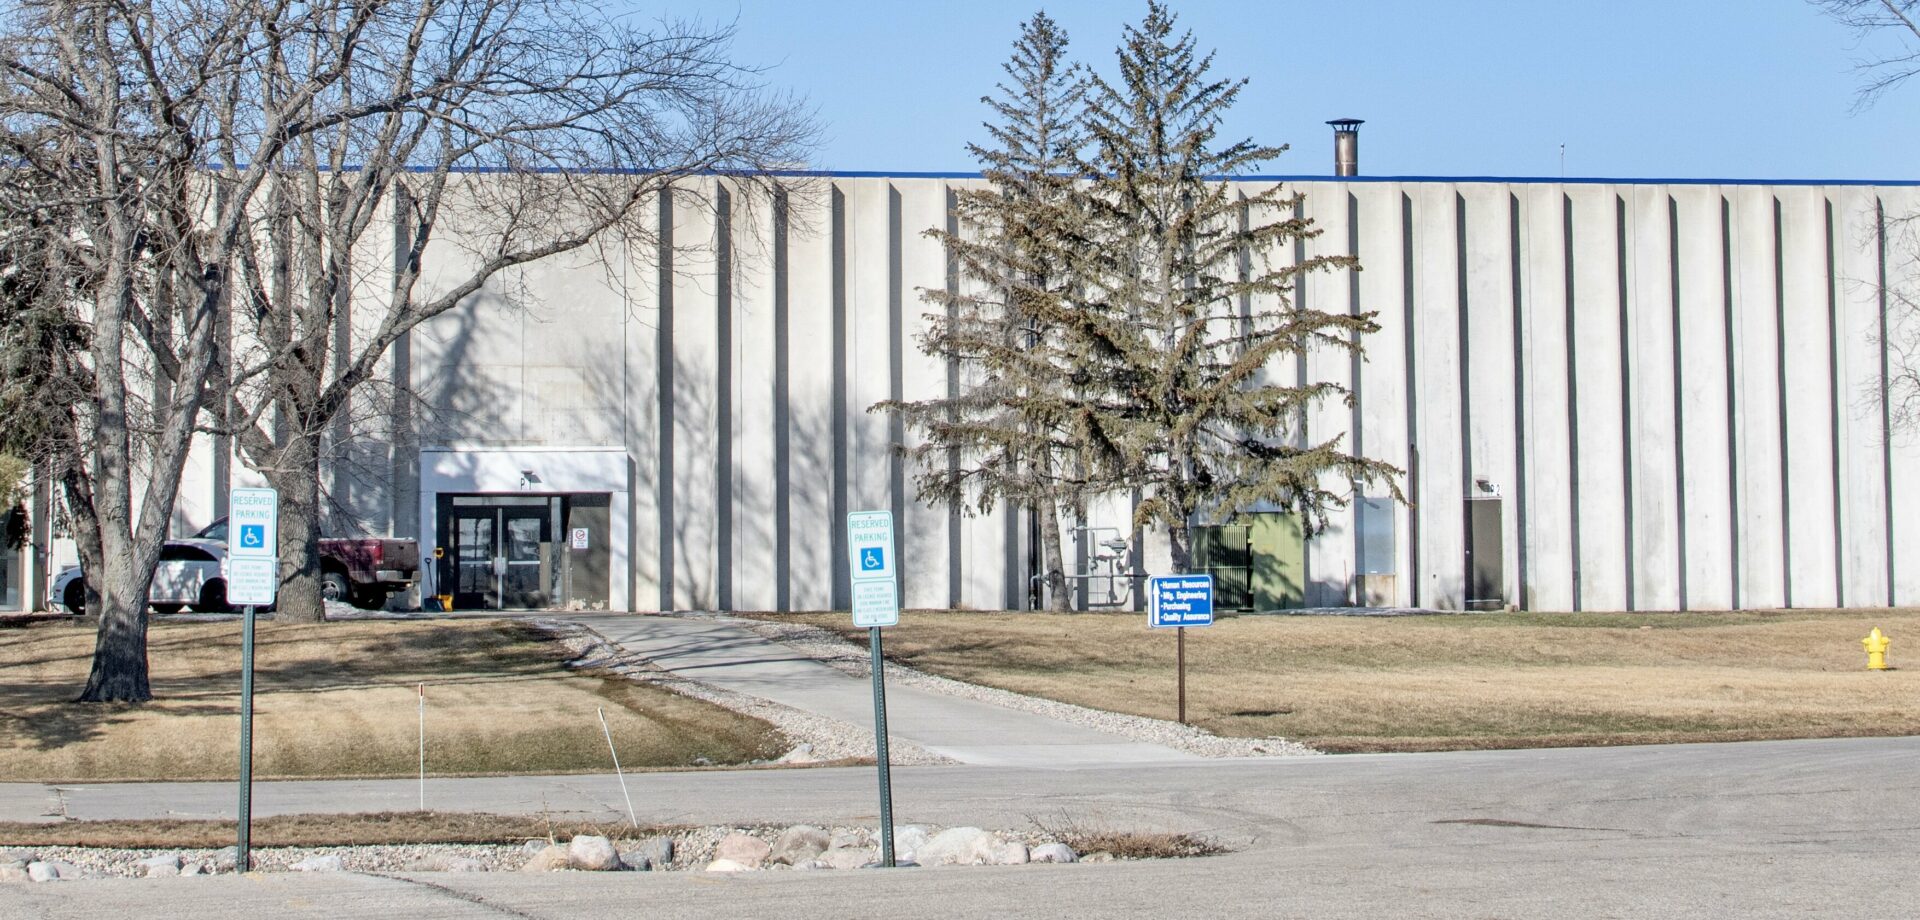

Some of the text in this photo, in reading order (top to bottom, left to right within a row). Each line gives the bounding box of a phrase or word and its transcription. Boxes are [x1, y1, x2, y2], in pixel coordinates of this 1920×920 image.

[233, 496, 273, 505] RESERVED
[236, 510, 270, 519] PARKING
[851, 520, 889, 529] RESERVED
[854, 532, 888, 542] PARKING
[1162, 580, 1210, 589] Human Resources
[1176, 591, 1207, 601] Engineering
[1163, 602, 1192, 611] Purchasing
[1163, 612, 1210, 622] Quality Assurance
